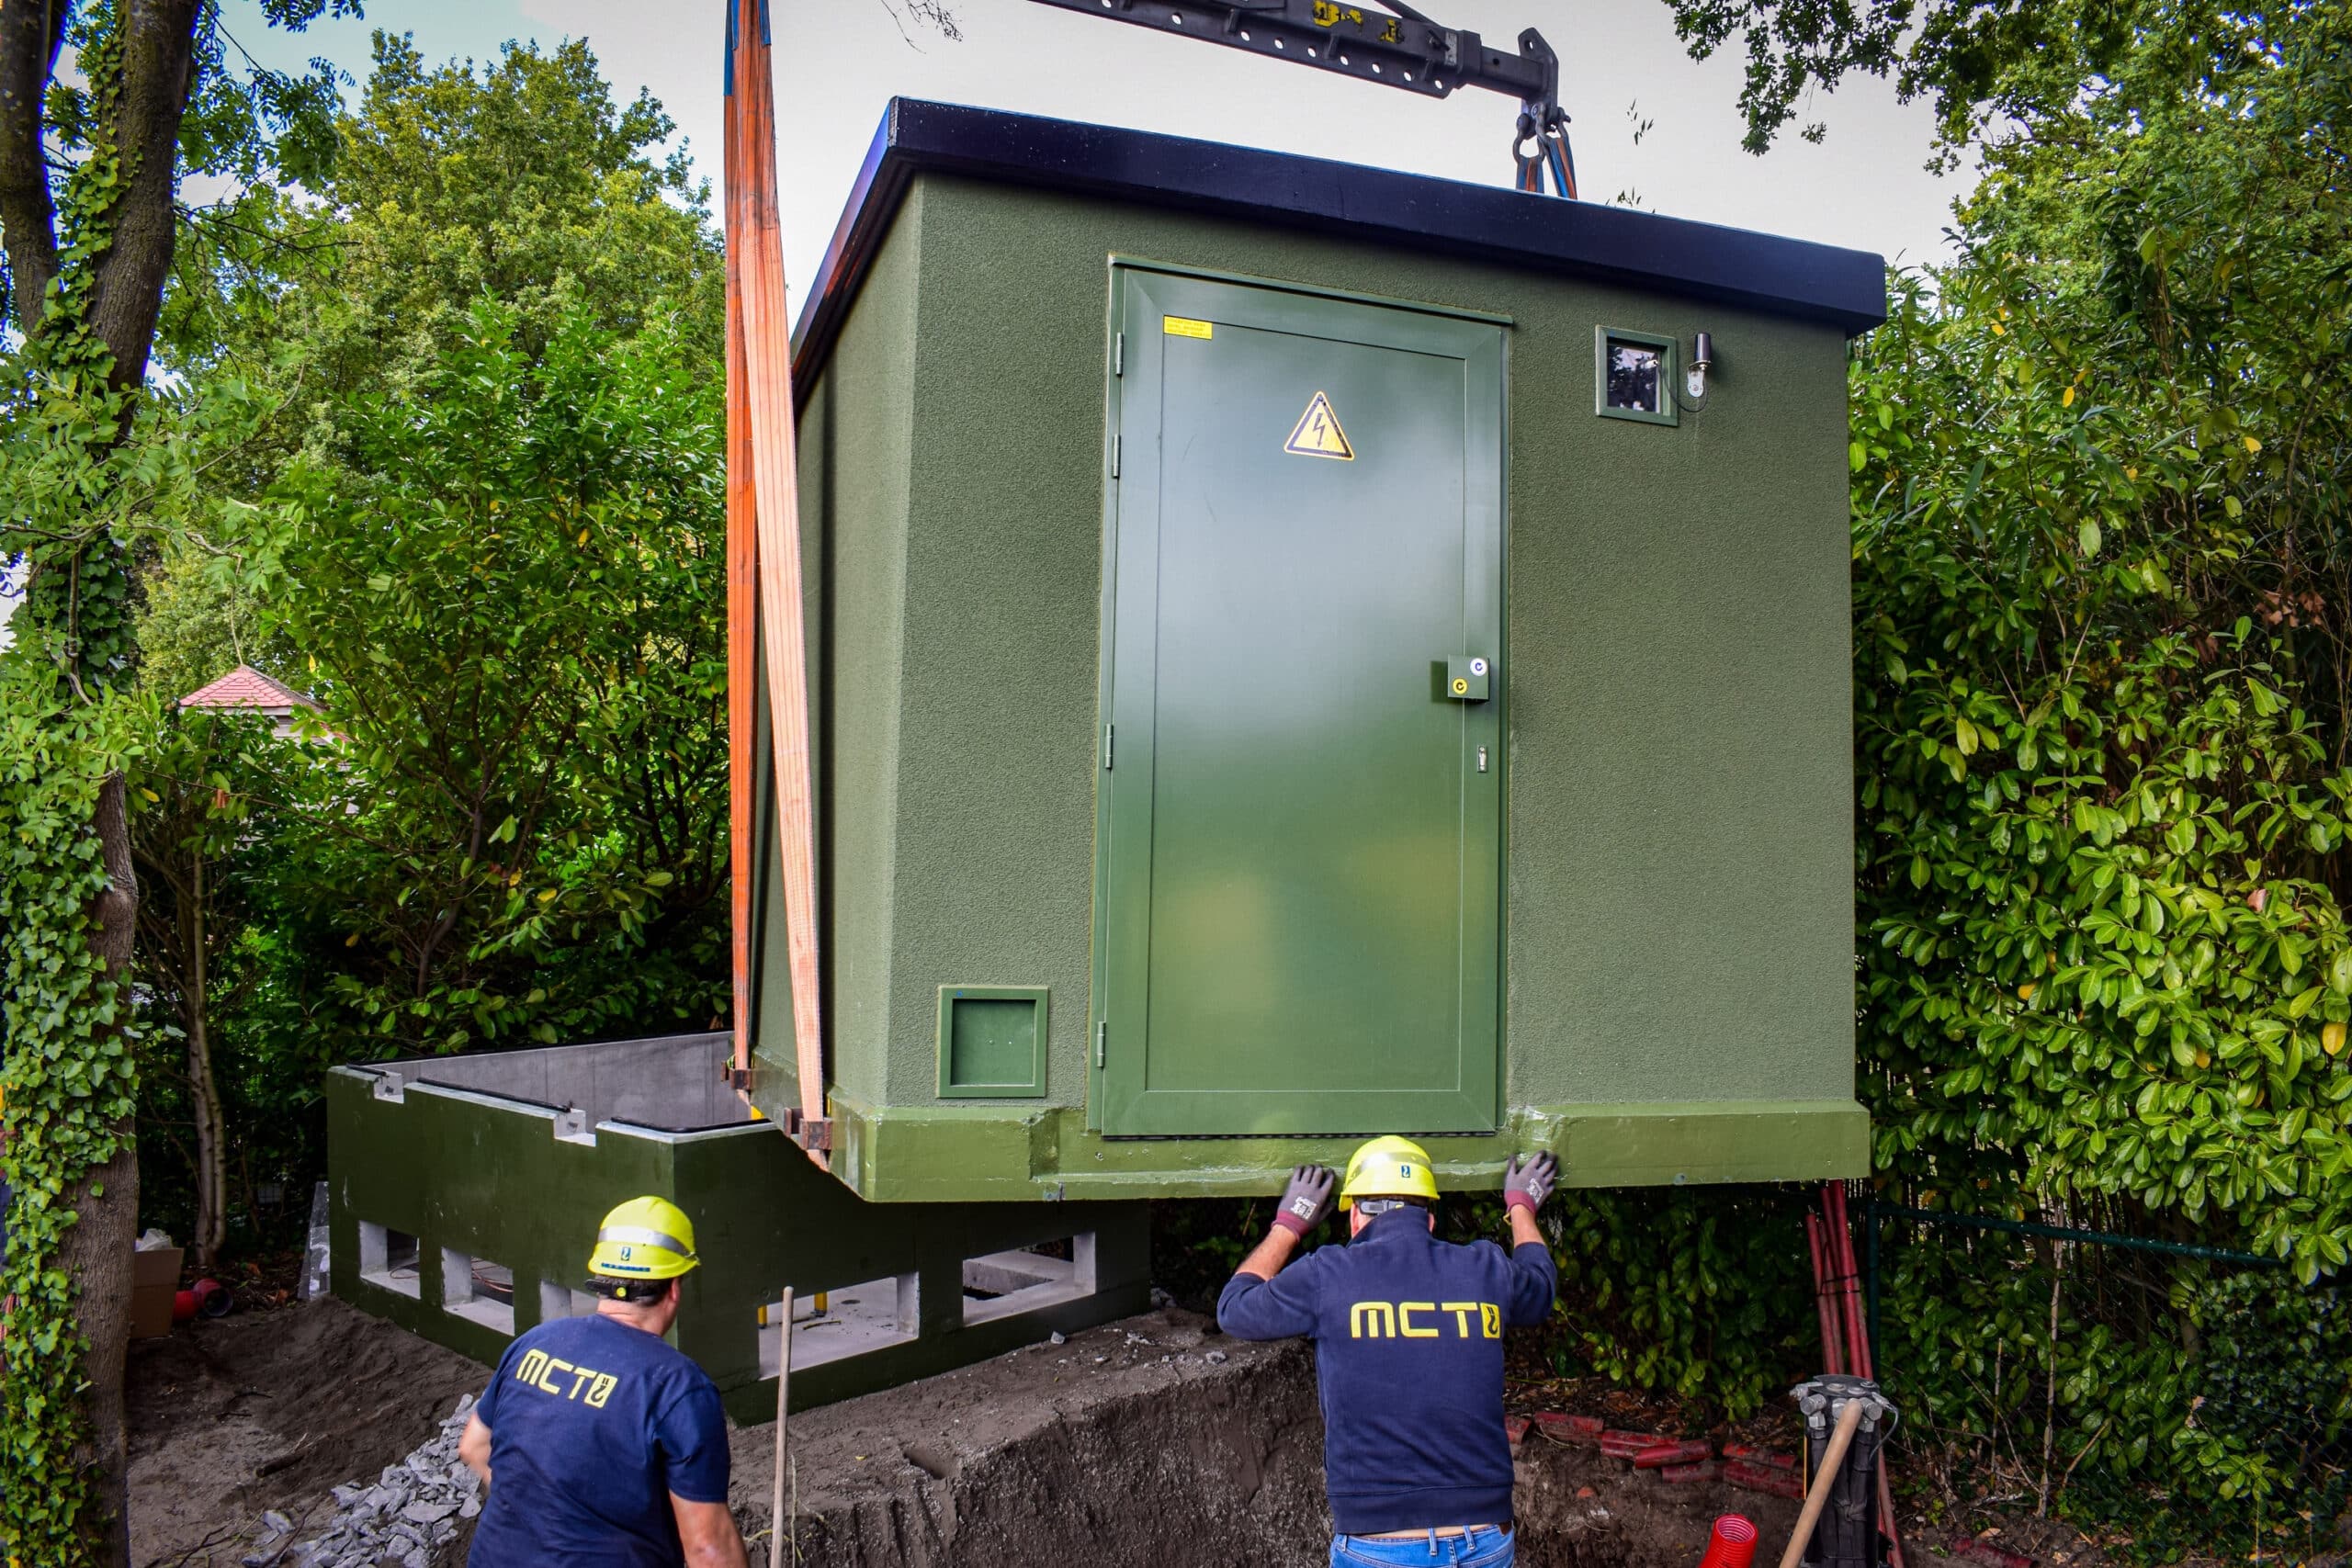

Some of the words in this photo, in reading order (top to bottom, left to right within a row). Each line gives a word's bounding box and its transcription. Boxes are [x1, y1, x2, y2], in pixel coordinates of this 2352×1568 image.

[1475, 662, 1483, 671] C
[1455, 682, 1464, 691] C
[1351, 1301, 1478, 1338] MCT
[515, 1348, 598, 1401] MCT
